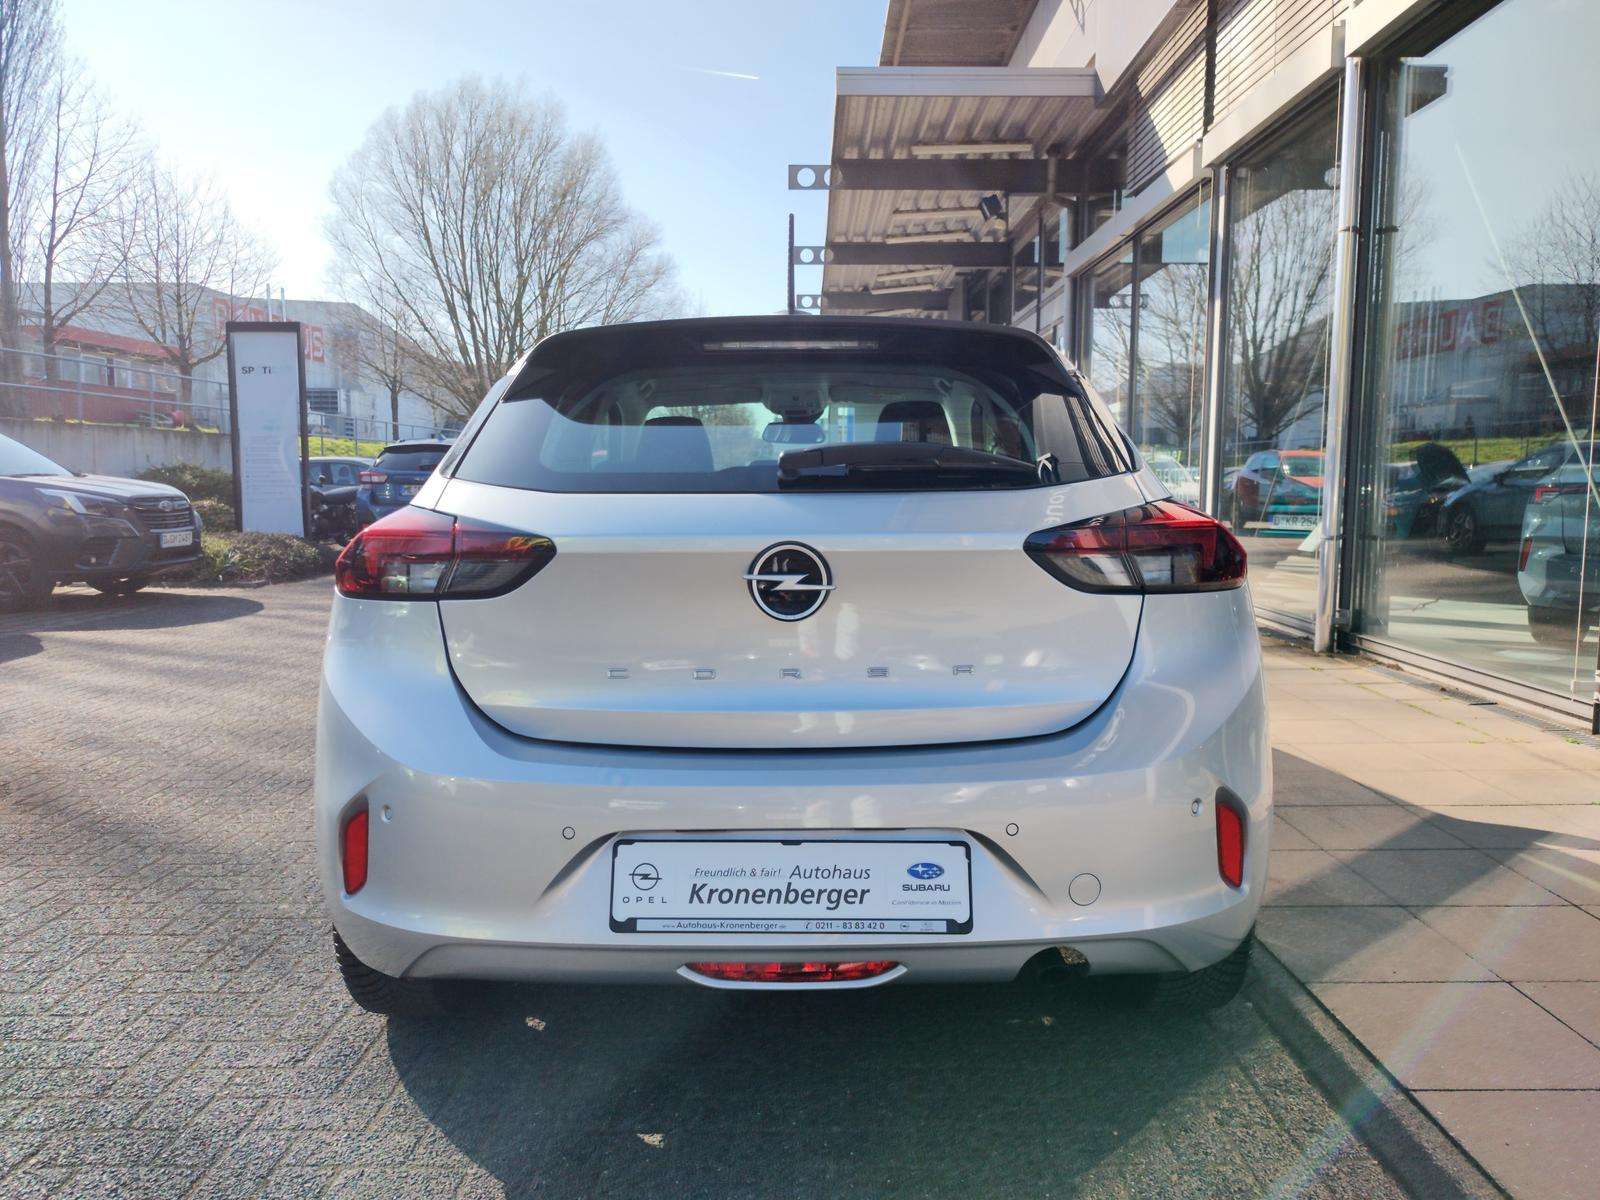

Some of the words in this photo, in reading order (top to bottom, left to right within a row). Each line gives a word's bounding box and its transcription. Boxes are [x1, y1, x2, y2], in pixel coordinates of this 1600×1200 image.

[608, 665, 976, 680] CORSA
[694, 867, 747, 878] Freundlich
[750, 867, 757, 877] &
[760, 867, 782, 878] fair!
[789, 865, 871, 880] Autohaus
[902, 884, 951, 892] SUBARU
[622, 896, 668, 904] OPEL
[688, 882, 871, 910] Kronenberger
[815, 922, 833, 930] 0211
[842, 922, 853, 930] 83
[854, 922, 865, 930] 83
[867, 922, 877, 930] 42
[879, 922, 885, 930] 0
